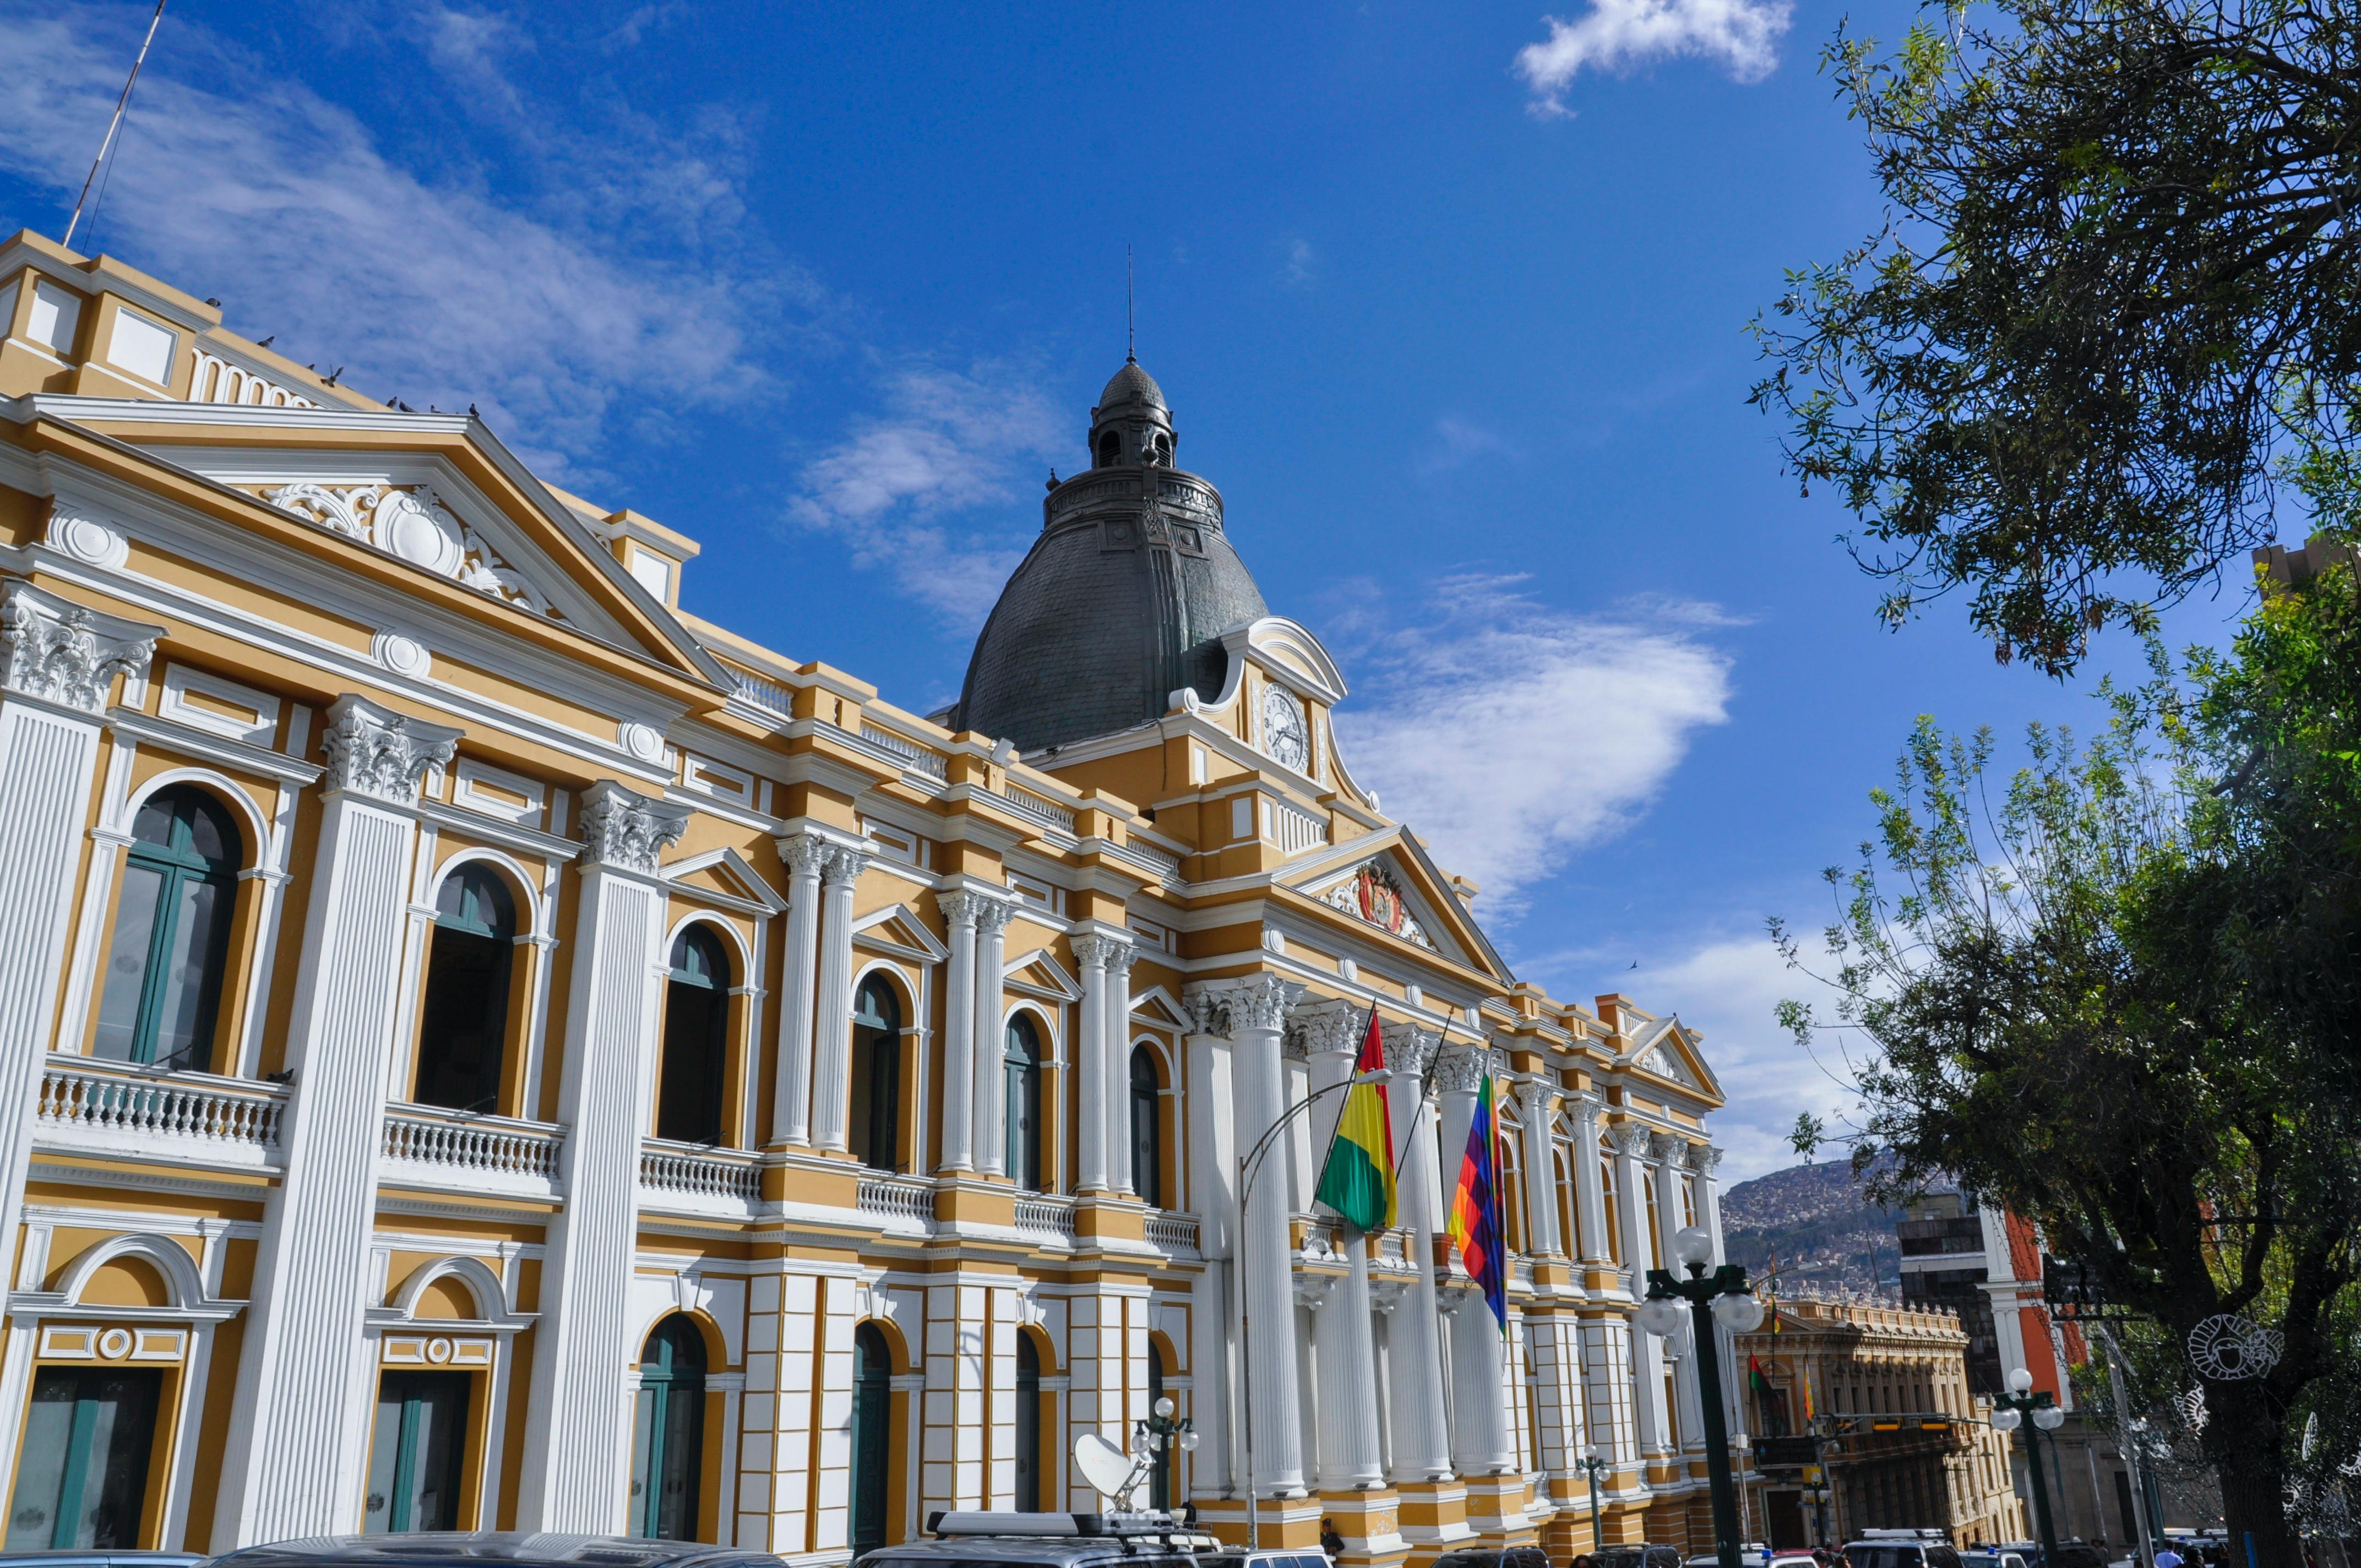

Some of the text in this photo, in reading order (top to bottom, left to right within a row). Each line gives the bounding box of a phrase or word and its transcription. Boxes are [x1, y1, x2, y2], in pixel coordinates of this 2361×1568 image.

[1272, 699, 1275, 707] 1
[1279, 699, 1286, 712] 12
[1267, 705, 1271, 714] 2
[1287, 711, 1292, 720] 11
[1264, 717, 1270, 728] 3
[1292, 722, 1297, 731] 10
[1267, 734, 1271, 743] 4
[1274, 749, 1278, 758] 5
[1294, 750, 1298, 759] 8
[1281, 754, 1286, 764] 6
[1290, 755, 1293, 764] 7
